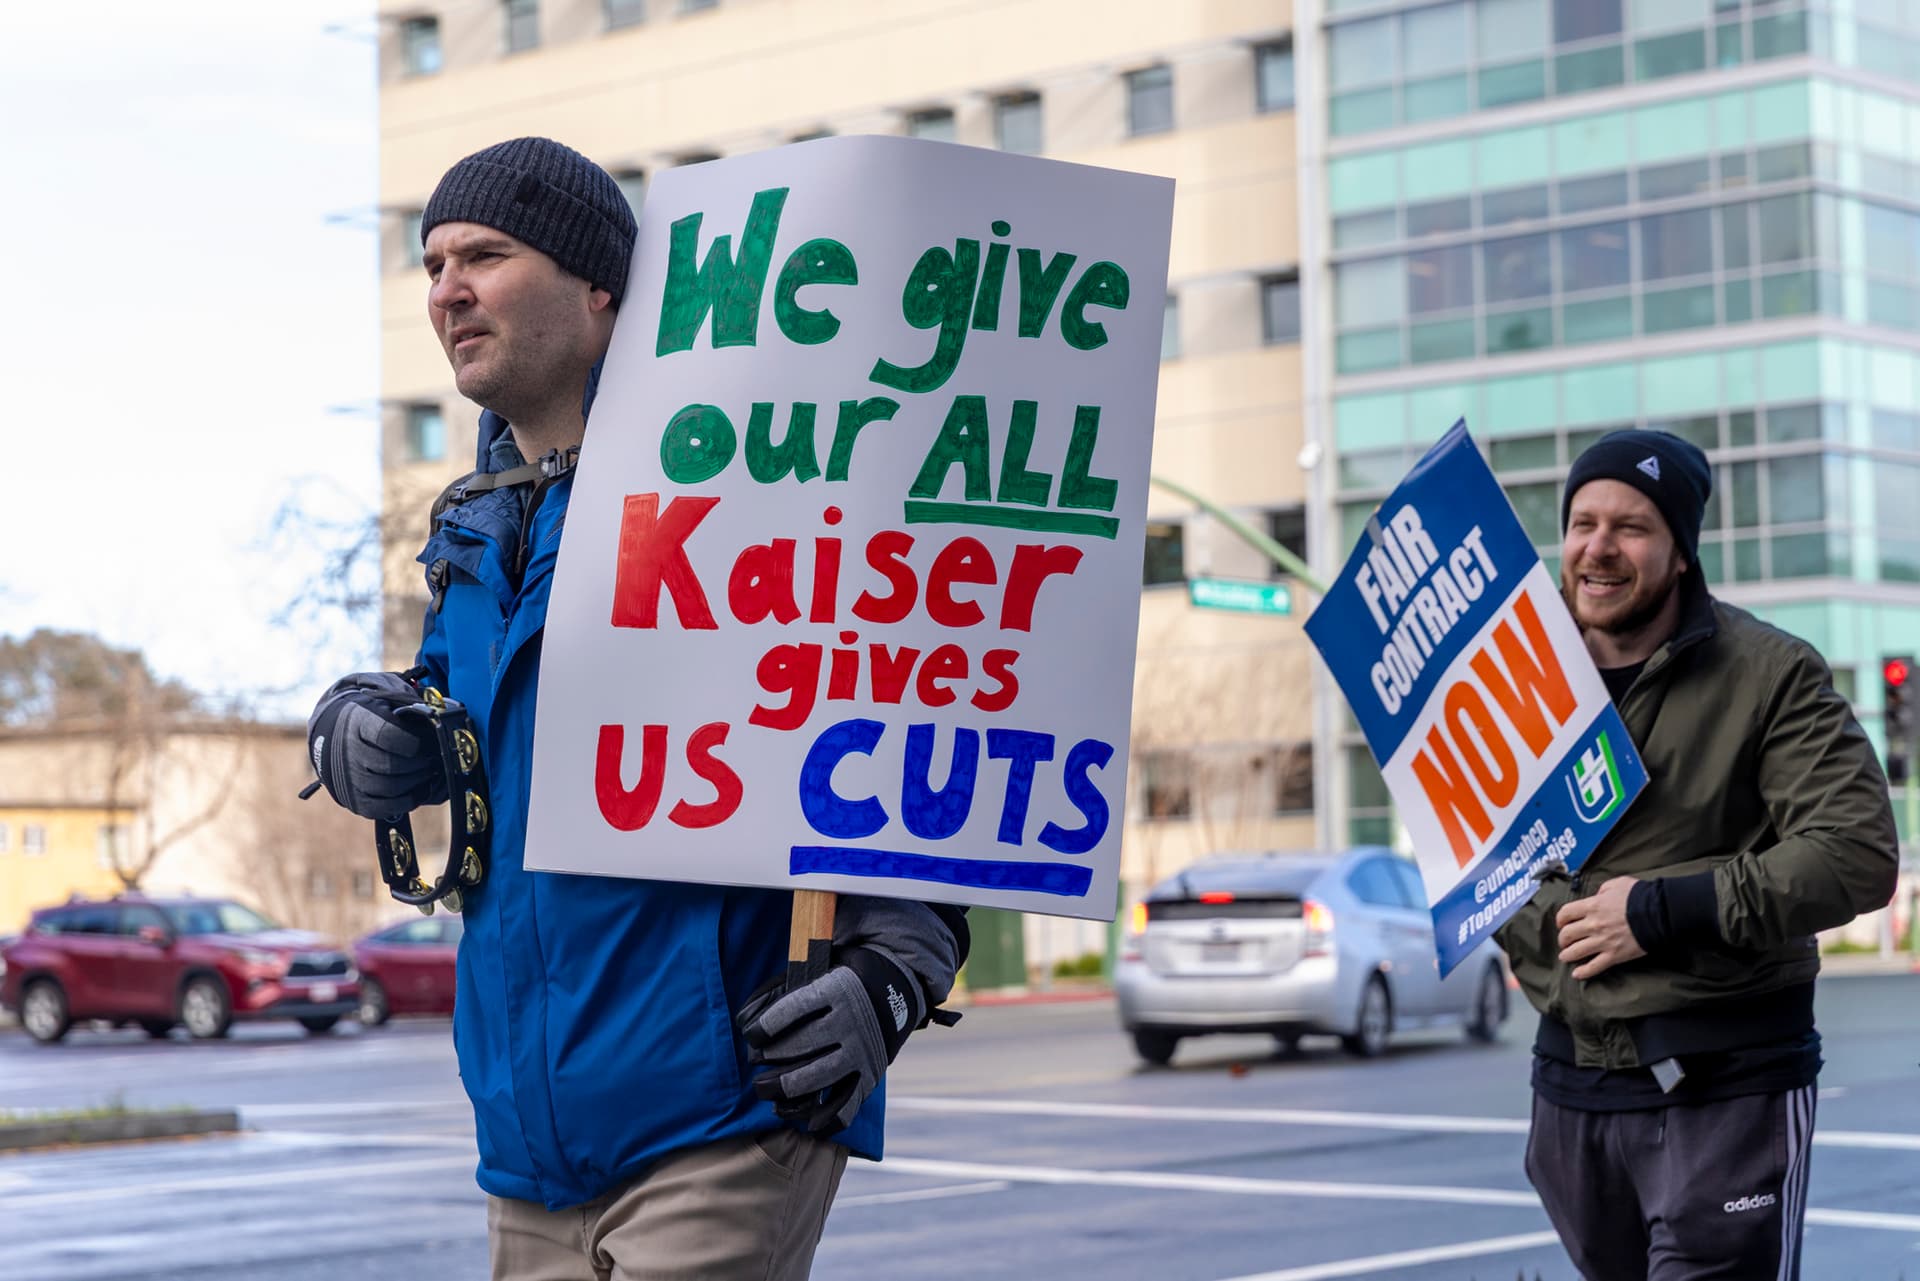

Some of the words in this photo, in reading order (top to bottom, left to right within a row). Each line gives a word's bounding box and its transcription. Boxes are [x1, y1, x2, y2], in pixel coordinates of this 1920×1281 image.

[656, 186, 859, 358] We
[869, 220, 1131, 393] give
[659, 396, 900, 485] our
[908, 395, 1118, 512] ALL
[610, 492, 1083, 633] Kaiser
[1354, 503, 1440, 636] FAIR
[1370, 524, 1499, 716] CONTRACT
[748, 631, 1020, 731] gives
[1411, 589, 1577, 869] NOW
[798, 717, 1114, 856] CUTS
[1474, 818, 1549, 905] @unacuhcp
[1723, 1193, 1777, 1213] adidas
